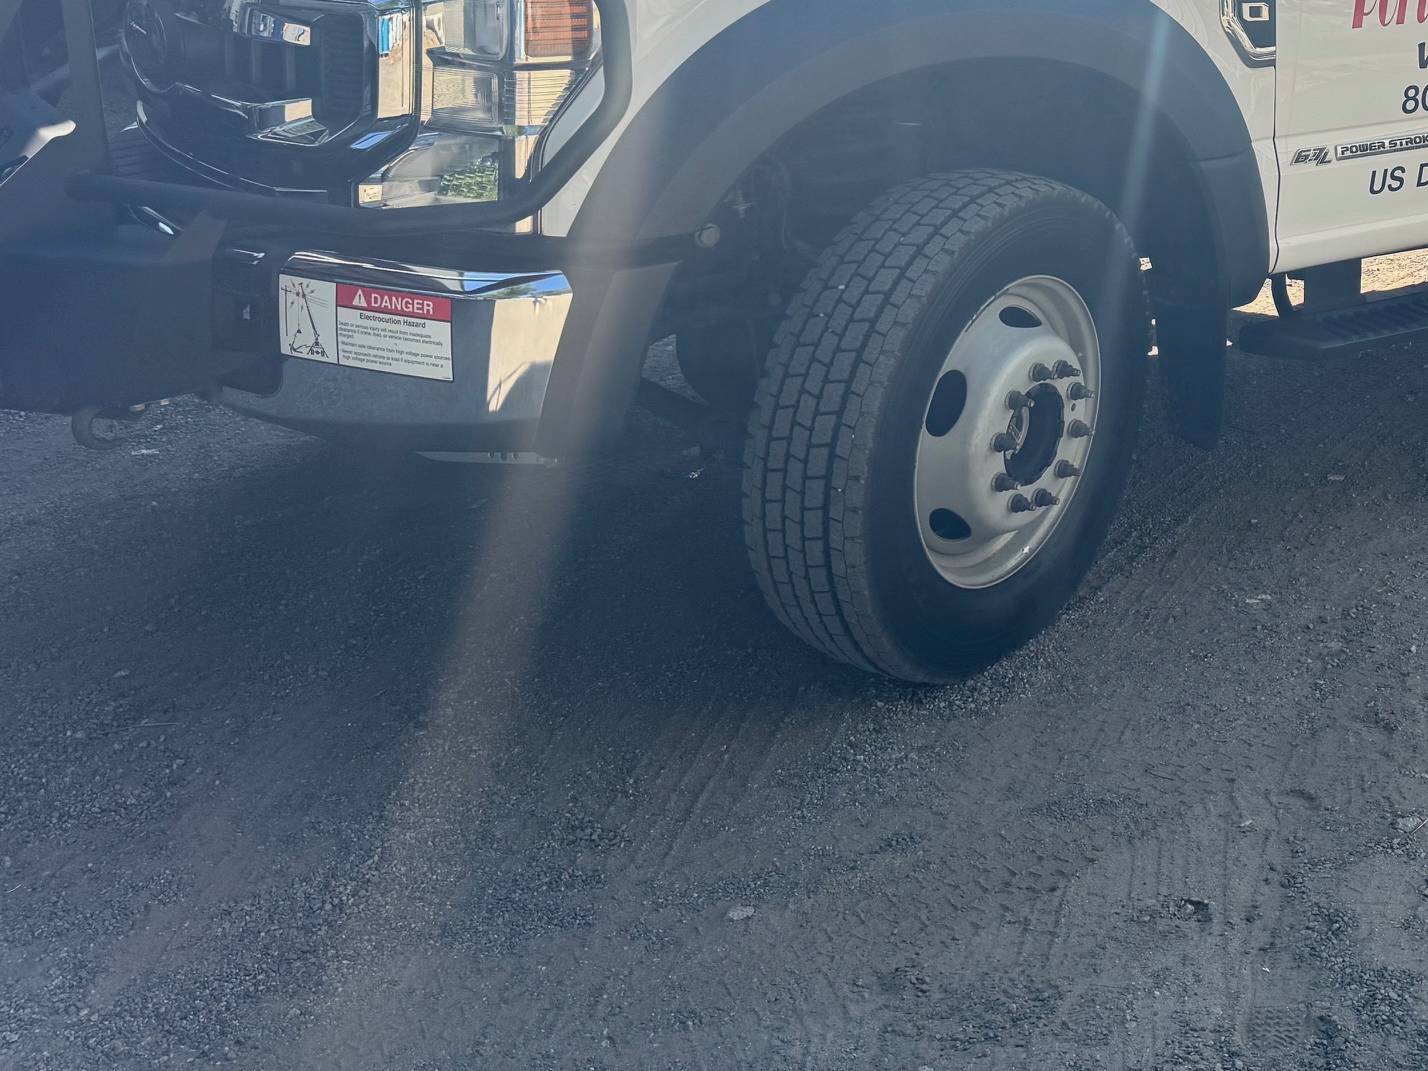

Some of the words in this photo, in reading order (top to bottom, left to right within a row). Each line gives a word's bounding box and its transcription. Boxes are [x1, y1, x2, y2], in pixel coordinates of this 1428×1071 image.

[1340, 141, 1386, 156] POWER
[1369, 166, 1406, 195] US
[371, 293, 434, 315] DANGER
[359, 312, 402, 326] Electrocution
[403, 318, 426, 329] Hazard
